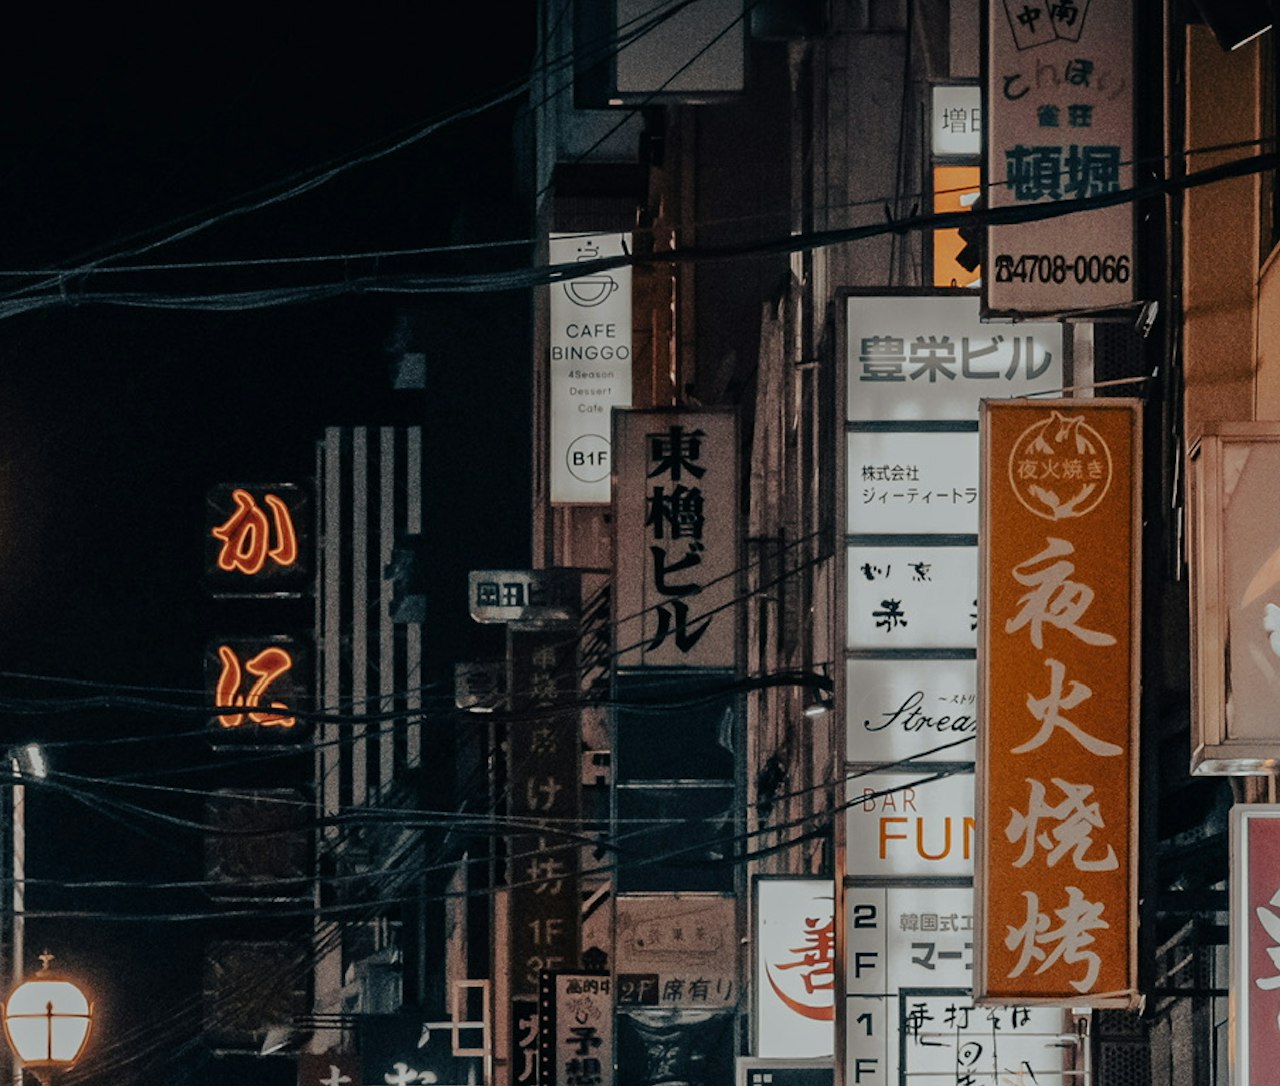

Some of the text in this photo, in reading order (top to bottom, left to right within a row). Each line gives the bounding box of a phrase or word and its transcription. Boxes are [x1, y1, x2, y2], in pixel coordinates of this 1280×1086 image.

[1005, 144, 1121, 201] 頓堀
[565, 323, 617, 339] CAFE
[551, 345, 631, 361] BINGGO
[858, 335, 1053, 383] 豊栄ビル
[569, 386, 612, 396] Dessert
[577, 403, 604, 414] Cafe
[572, 451, 609, 467] B1F
[1017, 459, 1105, 481] 夜火焼き
[861, 465, 920, 482] 株式会社
[644, 425, 712, 653] 東櫓ビル
[212, 490, 300, 728] かに
[862, 787, 918, 813] BAR
[662, 977, 735, 1003] 席有り
